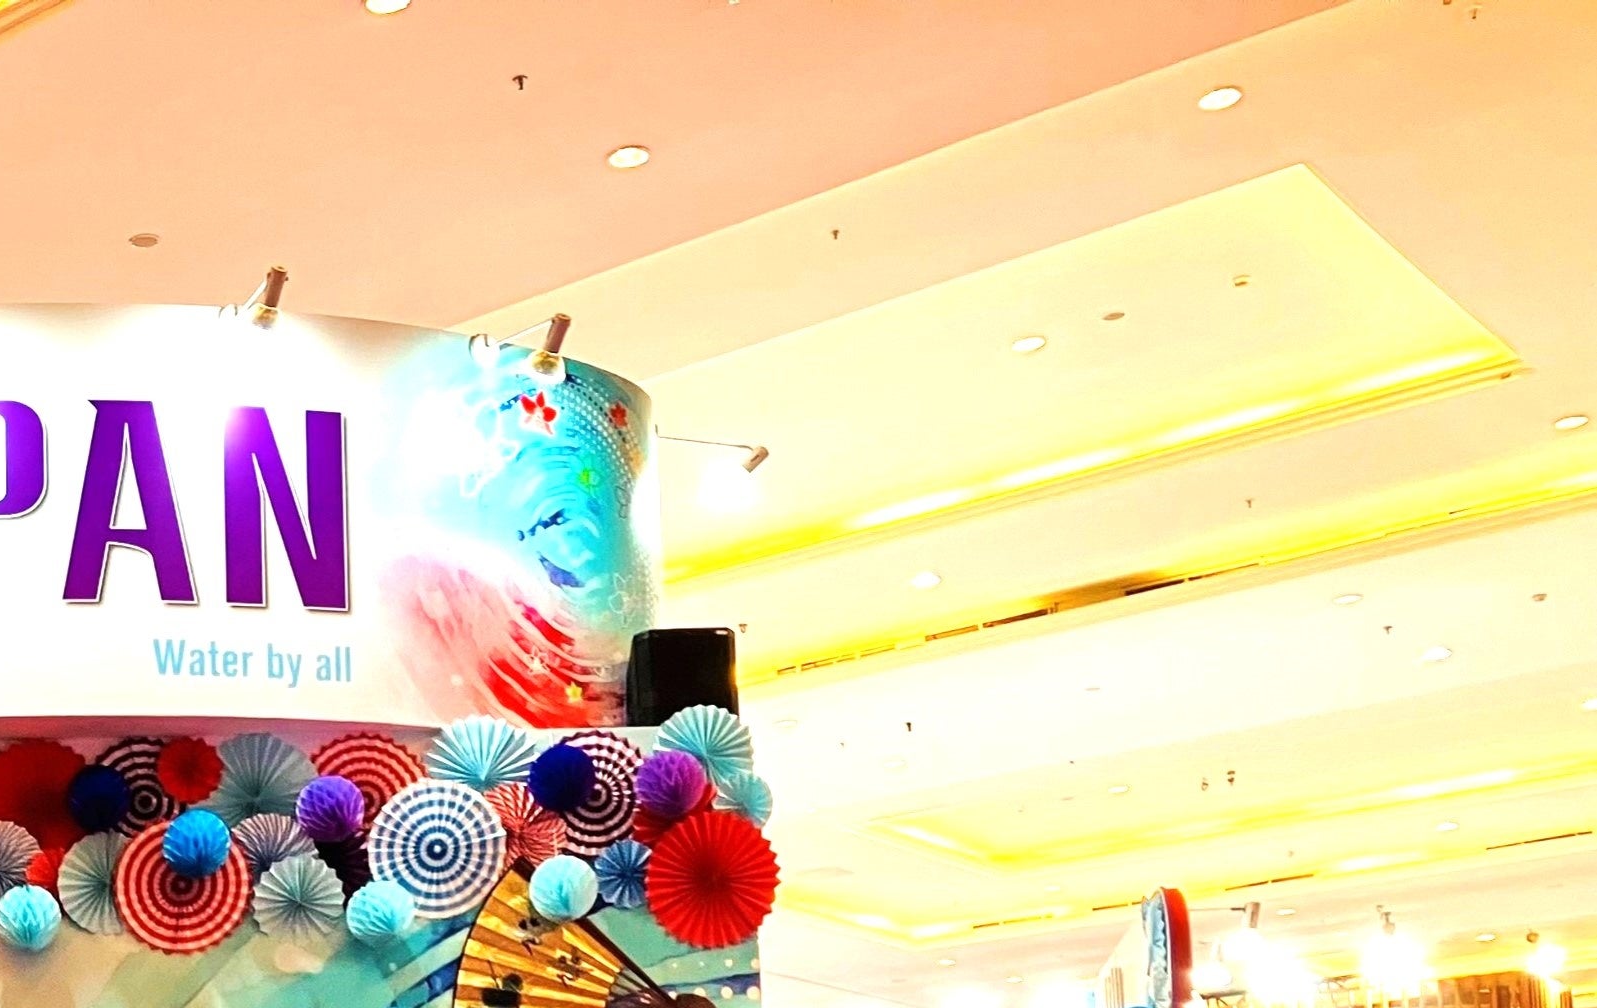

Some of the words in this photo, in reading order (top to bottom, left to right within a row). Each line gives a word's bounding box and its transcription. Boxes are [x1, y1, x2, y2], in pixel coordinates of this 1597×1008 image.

[153, 638, 254, 678] Water
[267, 642, 302, 689] by
[316, 645, 352, 683] all
